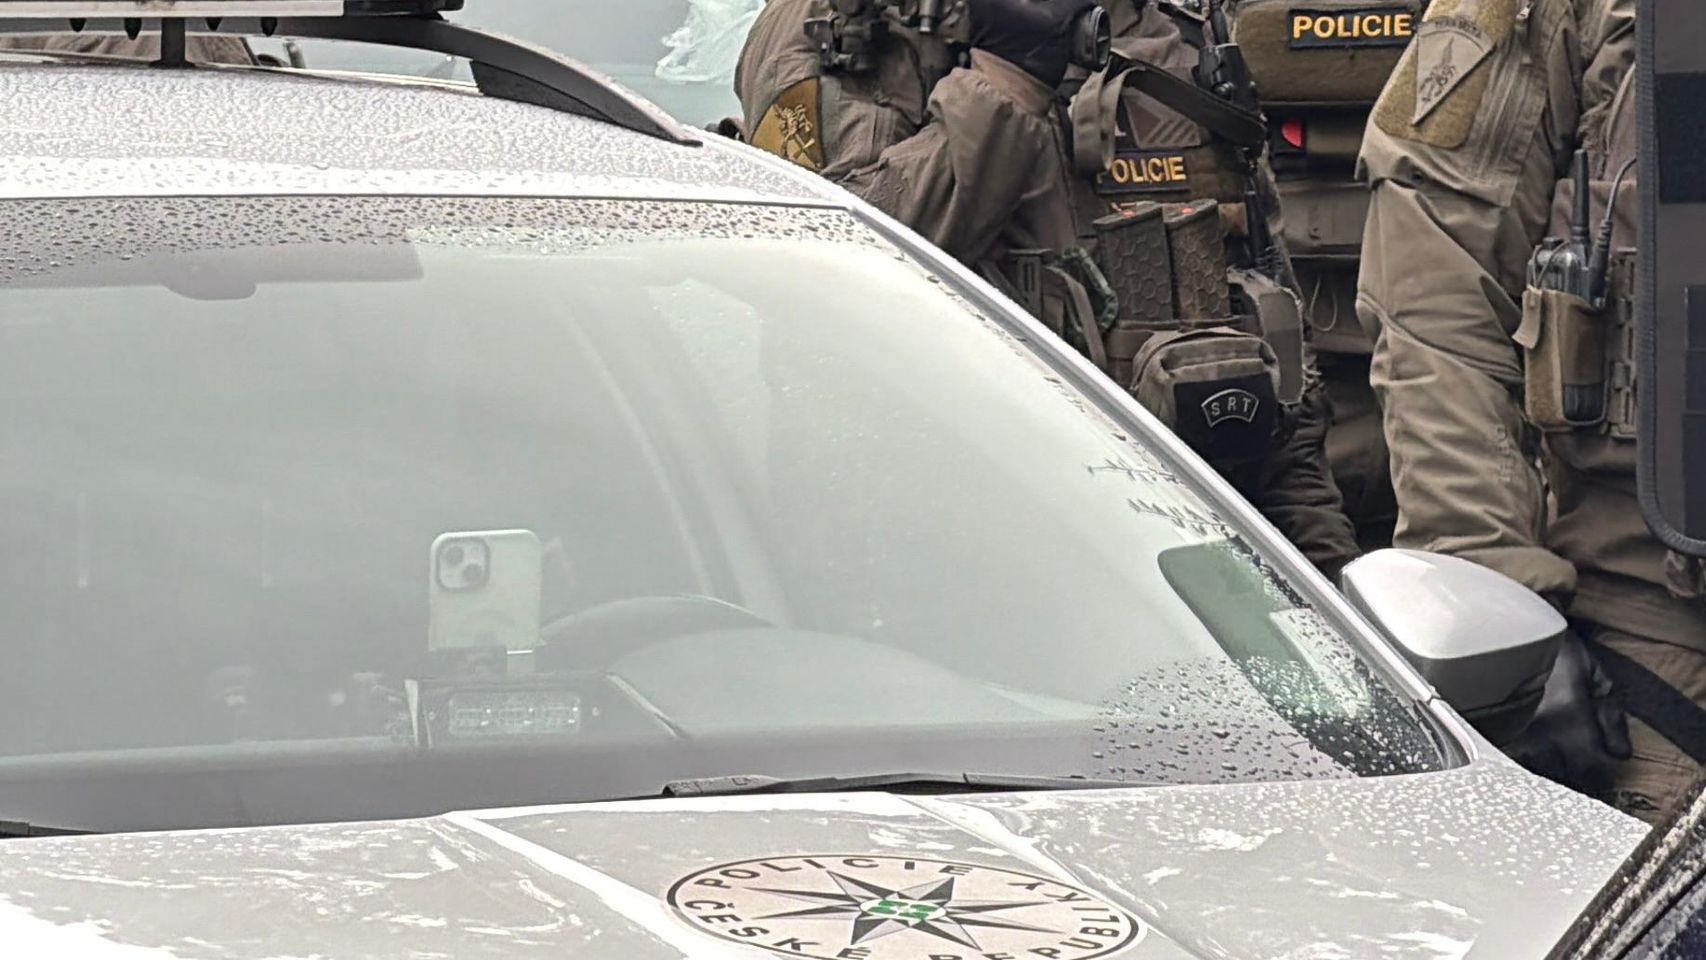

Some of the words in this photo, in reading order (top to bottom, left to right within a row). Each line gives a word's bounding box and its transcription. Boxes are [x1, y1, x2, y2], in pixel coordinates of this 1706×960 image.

[1292, 13, 1413, 39] POLICIE
[1110, 156, 1188, 184] OLICIE
[1210, 396, 1252, 417] SRT
[693, 857, 974, 890] POLICIE
